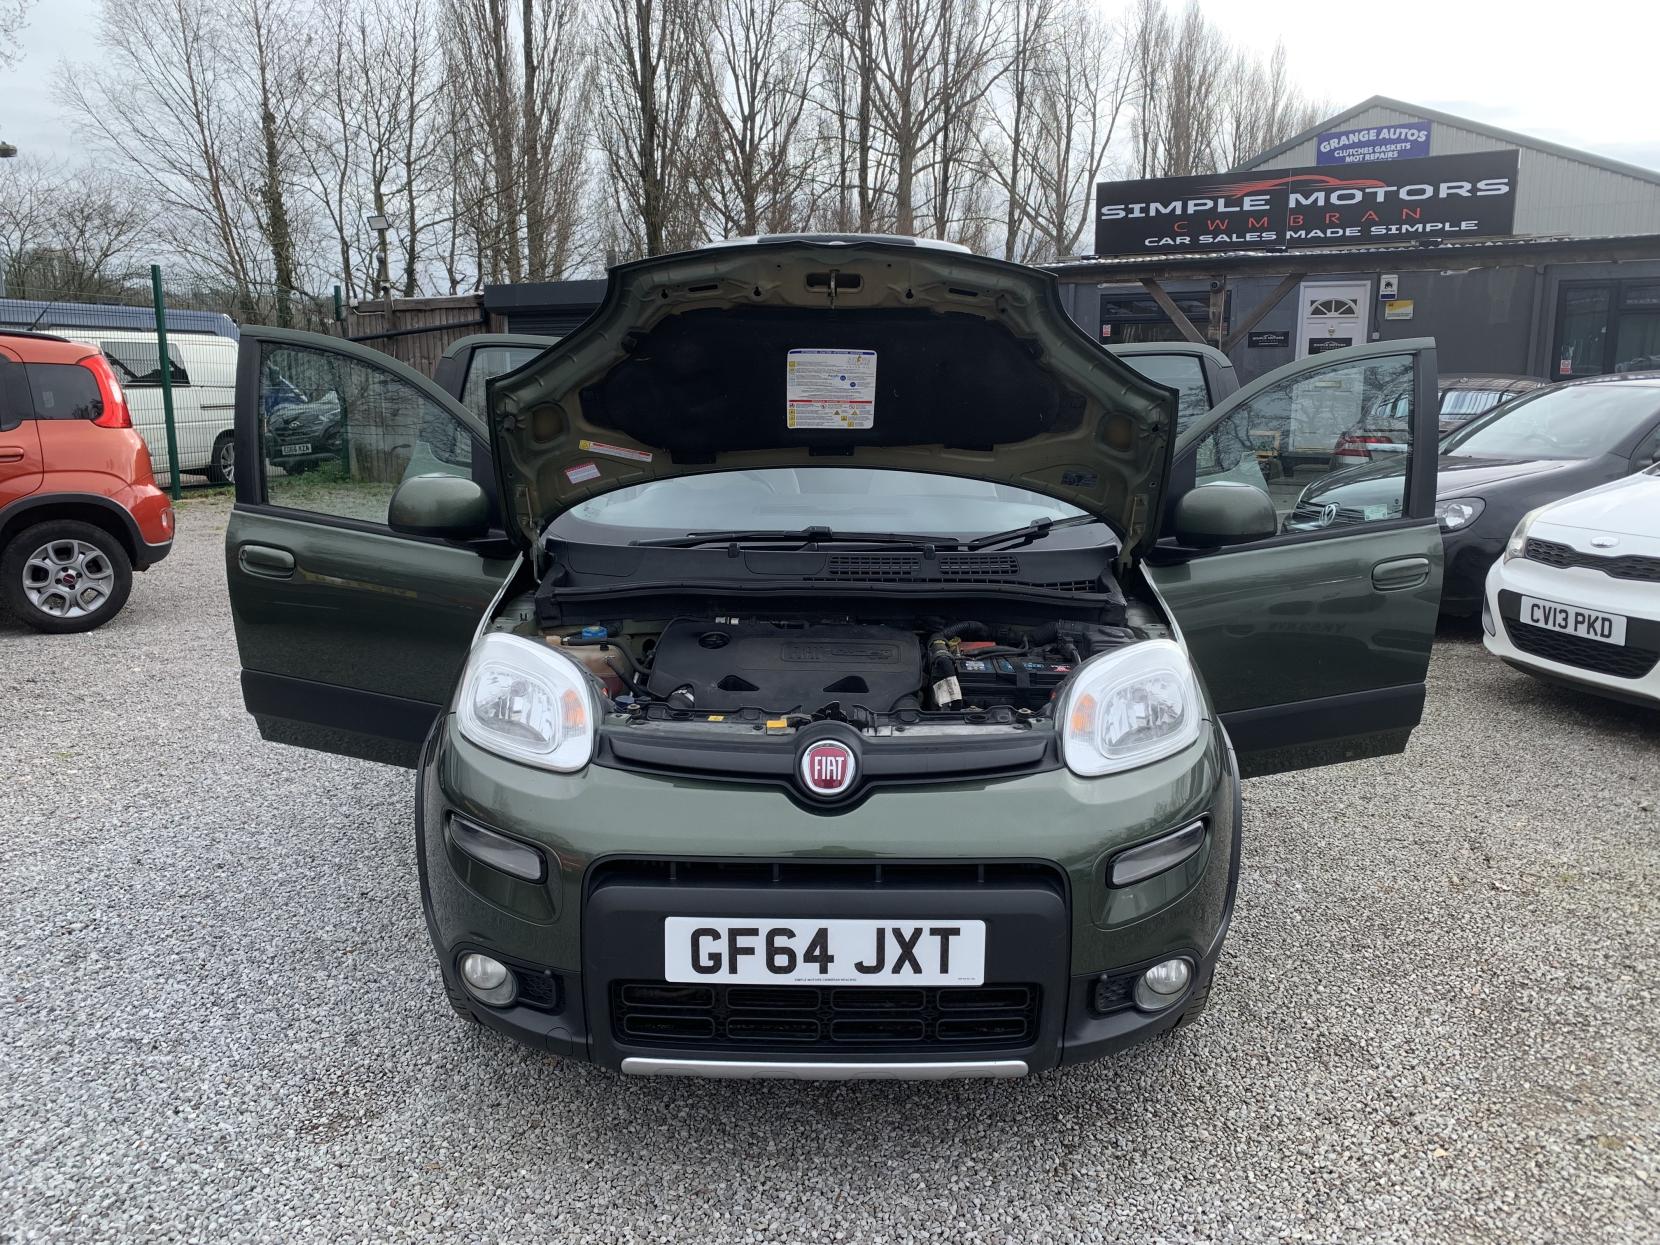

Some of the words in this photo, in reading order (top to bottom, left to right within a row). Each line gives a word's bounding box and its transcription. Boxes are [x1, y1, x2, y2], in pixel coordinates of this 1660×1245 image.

[1320, 129, 1377, 152] GRANGE
[1379, 128, 1428, 142] AUTOS
[1334, 146, 1373, 157] CLUTCHES
[1374, 142, 1411, 153] GASKETS
[1345, 154, 1364, 163] MOT
[1366, 151, 1398, 161] REPAIRS
[1101, 195, 1271, 220] SIMPLE
[1289, 178, 1510, 208] MOTORS
[1174, 207, 1421, 232] CWMBRAN
[1145, 236, 1191, 246] CAR
[1198, 231, 1277, 243] SALES
[1286, 227, 1361, 239] MADE
[1370, 220, 1479, 235] SIMPLE
[1530, 603, 1569, 630] CV13
[1573, 611, 1613, 639] PKD
[814, 756, 845, 780] FIAT
[690, 927, 834, 975] GF64
[854, 927, 961, 975] JXT
